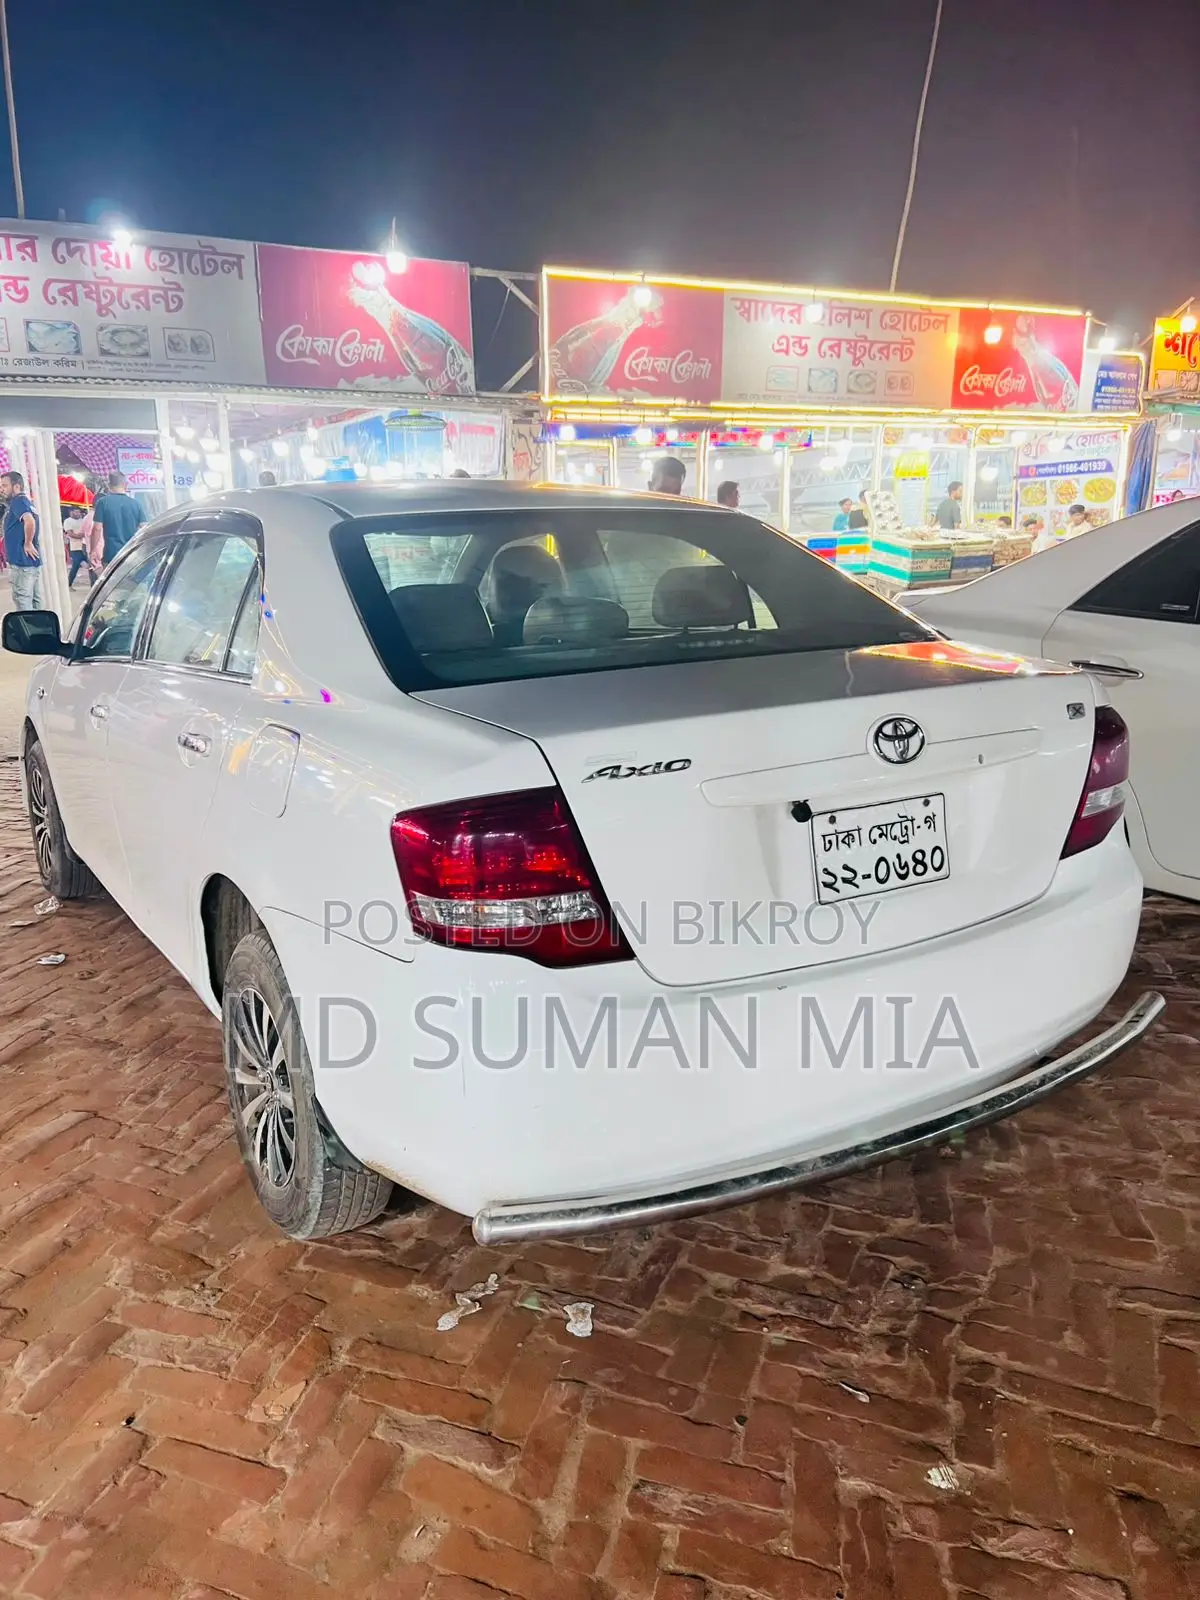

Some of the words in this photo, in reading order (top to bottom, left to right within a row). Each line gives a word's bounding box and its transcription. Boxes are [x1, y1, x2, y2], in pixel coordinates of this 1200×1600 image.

[0, 233, 38, 262] ার
[145, 240, 245, 280] হোটেল
[731, 297, 804, 325] স্বাদের
[880, 307, 950, 334] হোটেল
[276, 324, 336, 366] কোকা
[335, 329, 385, 367] কোলা
[624, 346, 674, 382] কোকা
[670, 350, 712, 384] কোলা
[821, 825, 862, 852] ঢাকা
[821, 845, 945, 893] ২২-০৬৪০
